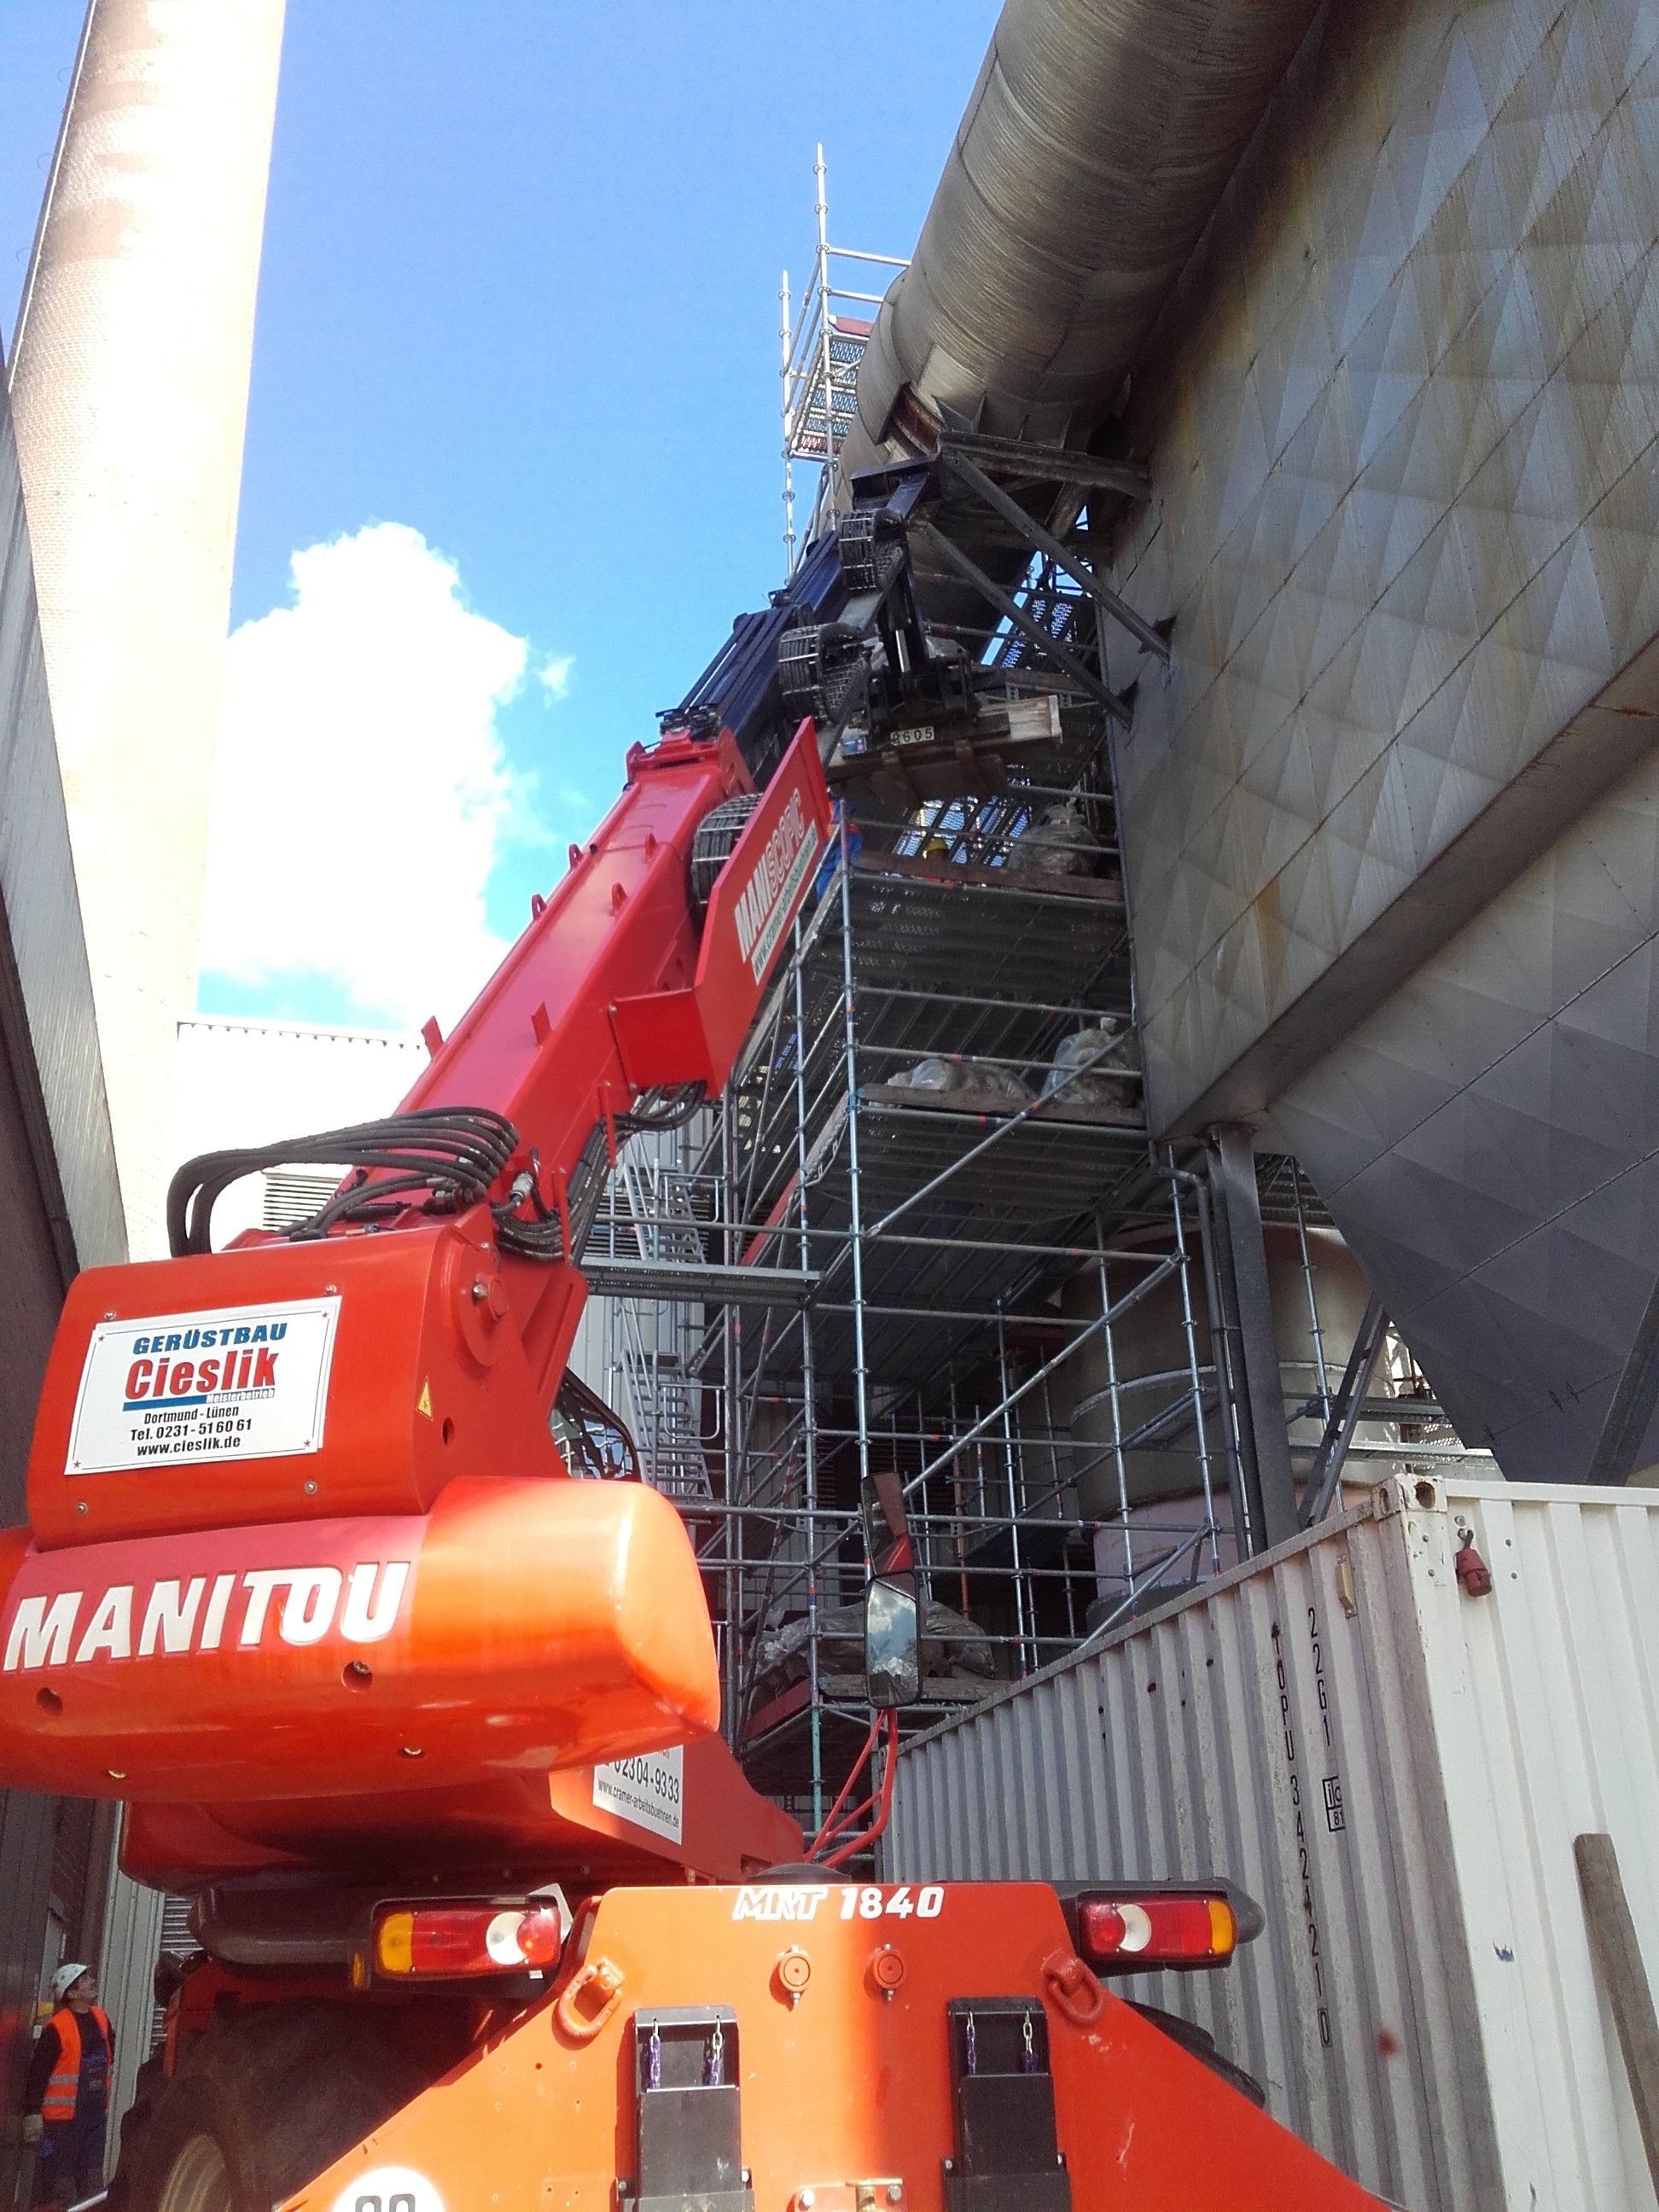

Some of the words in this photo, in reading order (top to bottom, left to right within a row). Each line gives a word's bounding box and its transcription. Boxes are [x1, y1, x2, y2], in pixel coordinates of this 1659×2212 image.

[133, 1323, 288, 1355] GERÜSTBAU
[125, 1347, 279, 1400] Cieslik
[207, 1388, 274, 1404] Meisterbetrieb
[144, 1409, 198, 1424] Dortmund
[207, 1406, 239, 1418] Lünen
[131, 1429, 154, 1441] Tel.
[156, 1424, 189, 1438] 0231
[137, 1436, 242, 1456] www.cieslik.de
[3, 1561, 411, 1671] MANITOU
[1308, 1607, 1330, 1747] 22G1
[597, 1778, 679, 1828] www.cramer-arbeitsbuehnen.de
[731, 1887, 828, 1920] MRT
[840, 1887, 944, 1919] 1840
